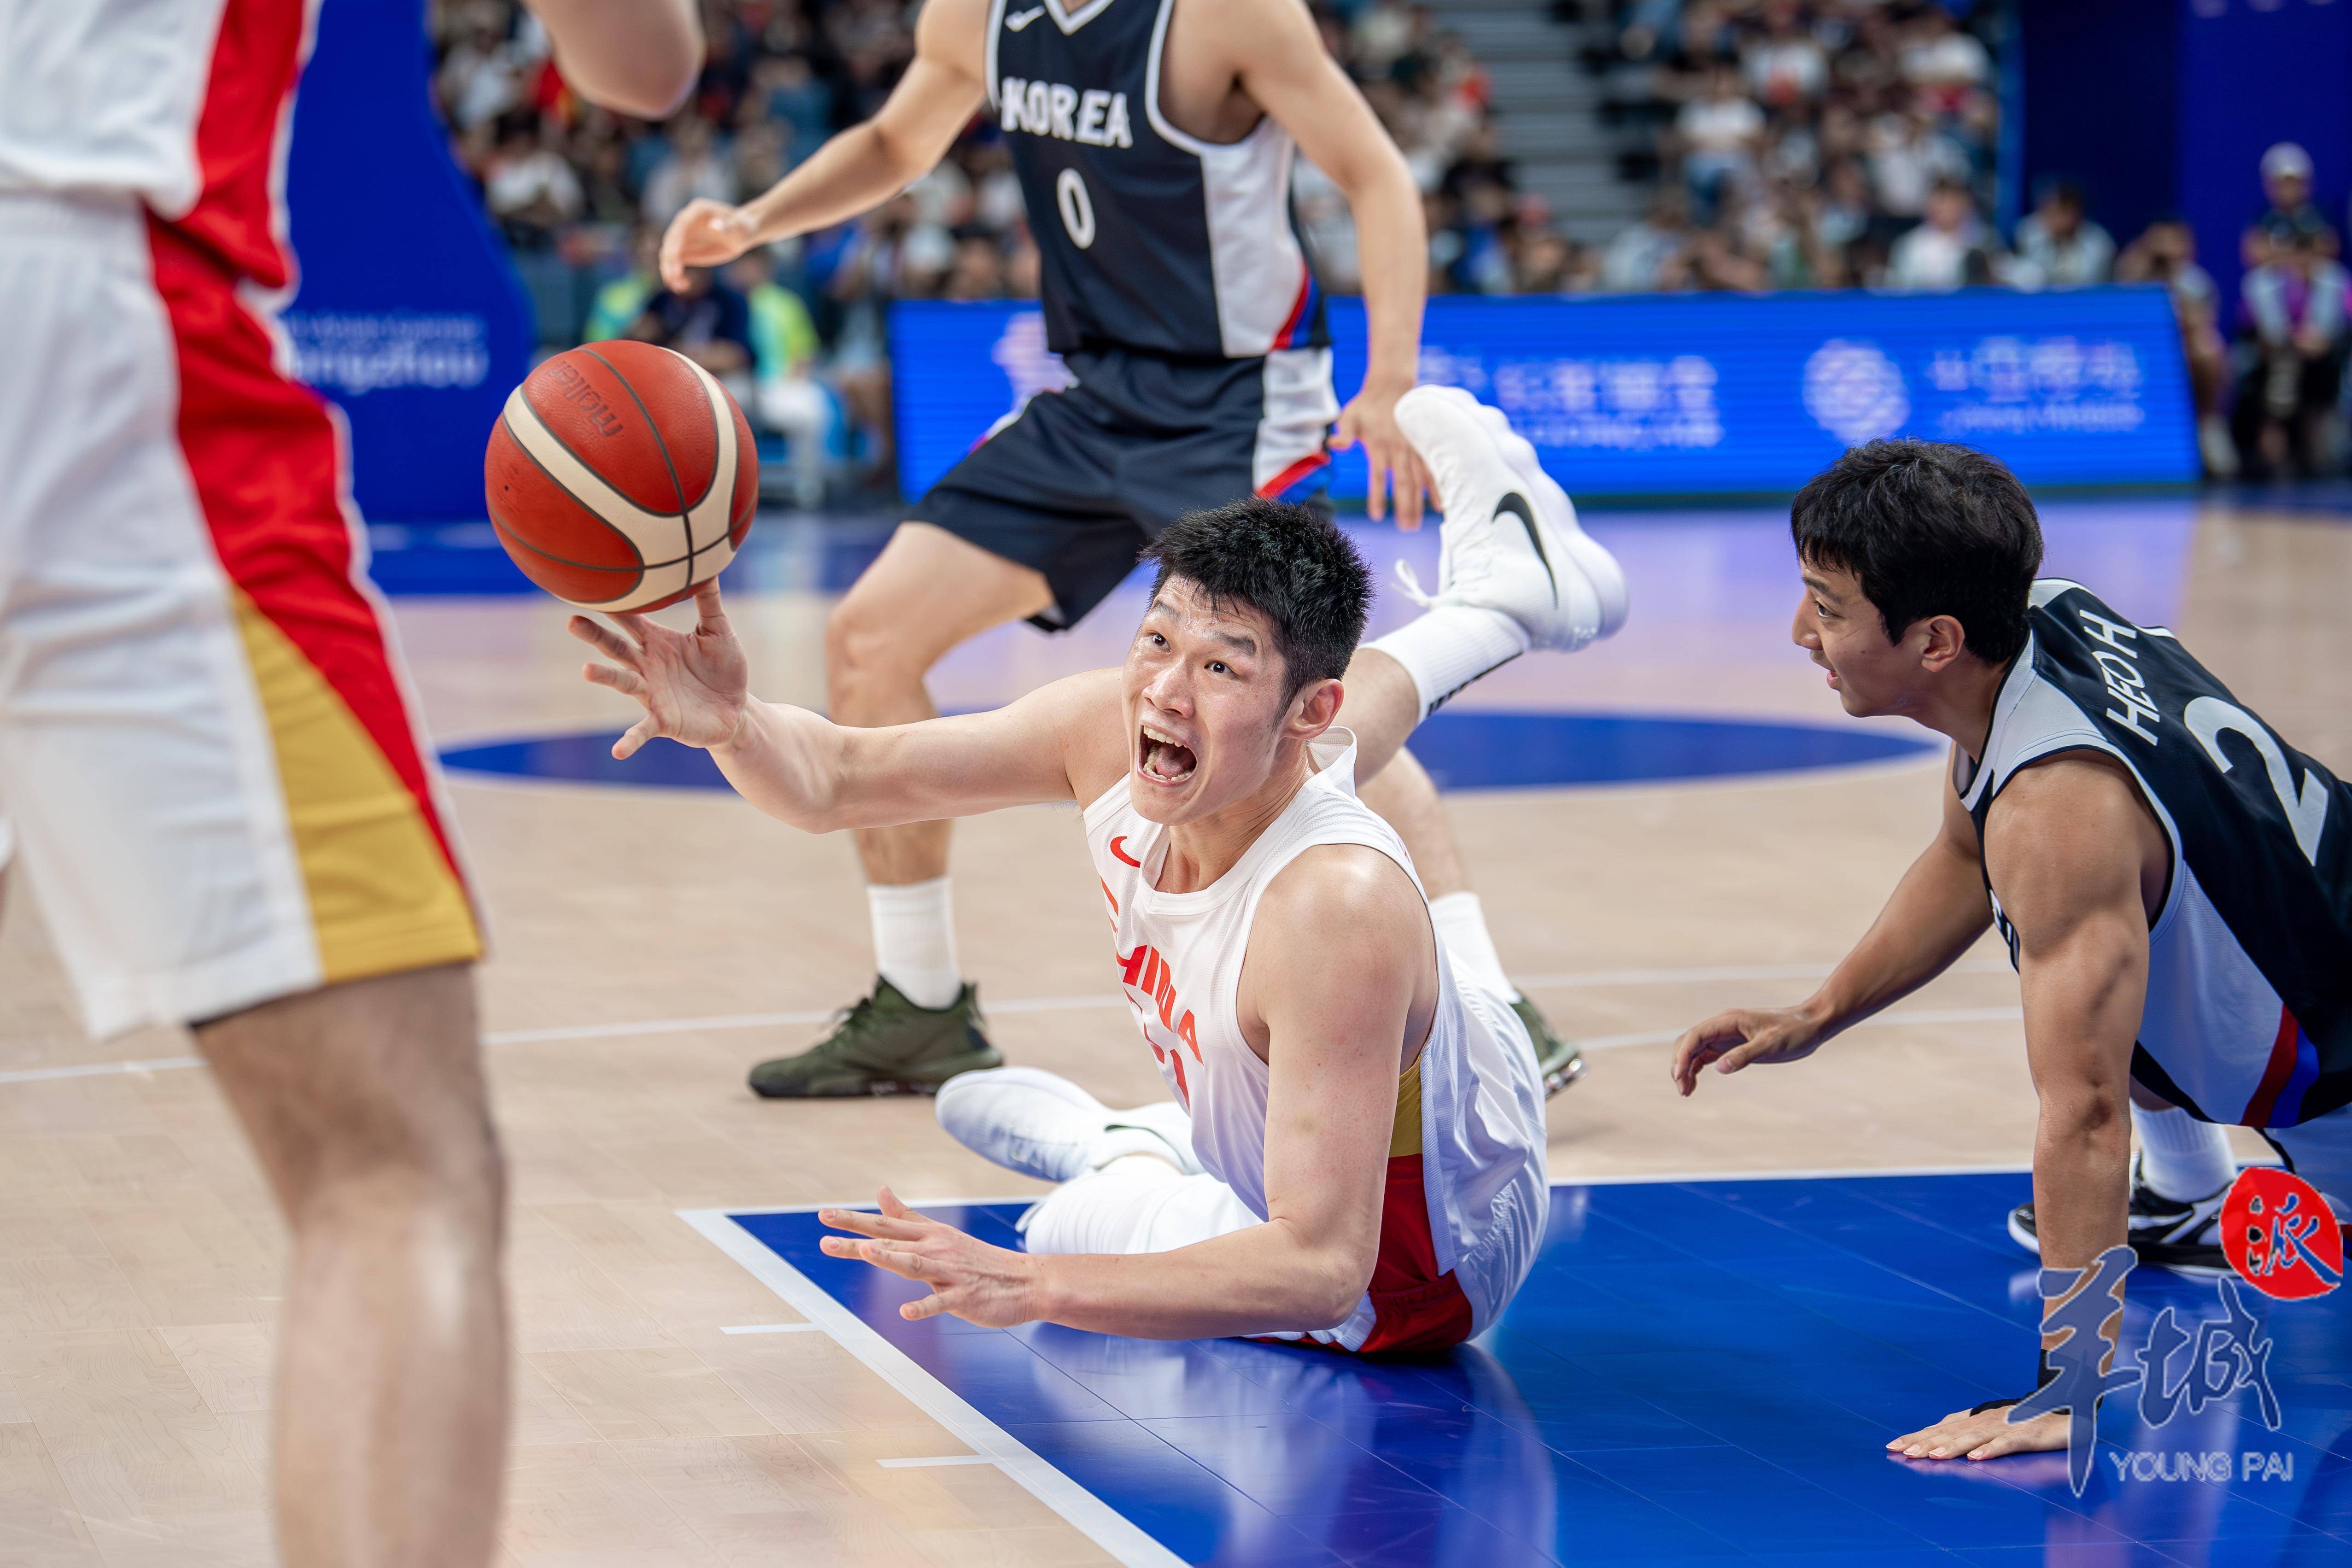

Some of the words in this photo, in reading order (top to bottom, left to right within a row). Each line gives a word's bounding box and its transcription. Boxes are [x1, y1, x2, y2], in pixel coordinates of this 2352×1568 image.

[1000, 76, 1133, 149] KOREA
[1057, 167, 1095, 249] 0
[549, 360, 623, 437] molten
[2184, 696, 2329, 867] 2
